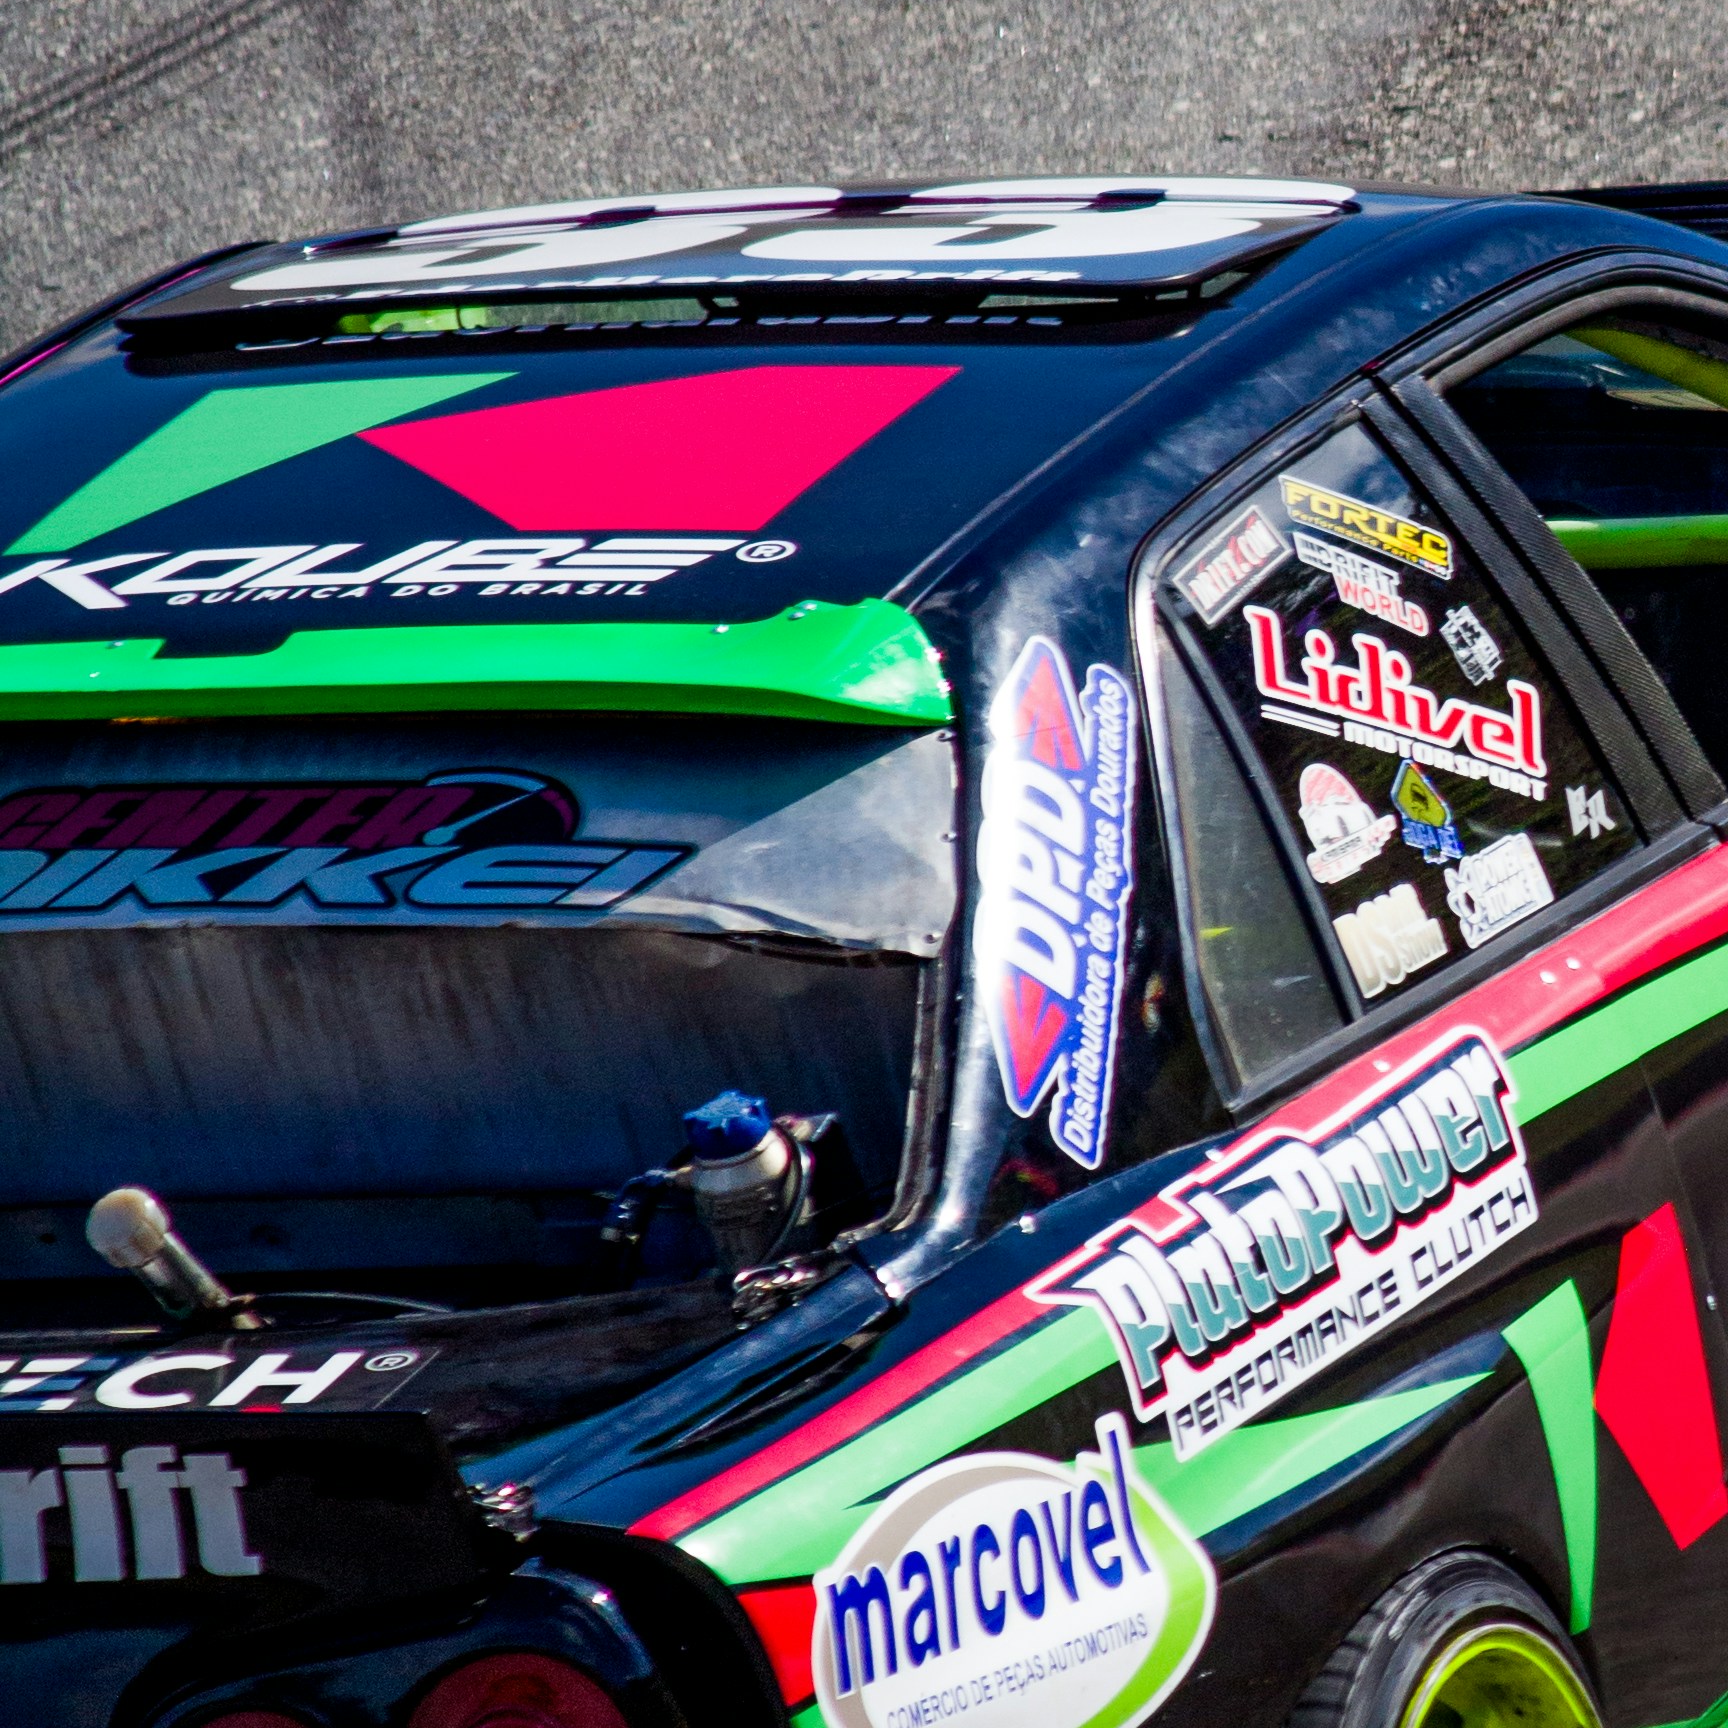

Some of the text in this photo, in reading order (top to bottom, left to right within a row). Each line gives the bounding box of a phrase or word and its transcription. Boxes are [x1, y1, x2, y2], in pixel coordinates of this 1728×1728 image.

[1285, 482, 1449, 566] FORTEC
[1292, 509, 1385, 551] Performance
[390, 583, 462, 598] DO
[477, 582, 650, 597] BRASIL
[1337, 576, 1428, 634] WORLD
[1246, 608, 1545, 776] Lidivel
[1344, 722, 1548, 801] MOTORSPORT
[0, 846, 692, 906] IKKEI
[1000, 759, 1088, 999] DPD
[1063, 678, 1128, 1154] Distribuidora de Peças Dourados
[1077, 1049, 1508, 1387] PlutoPower
[1175, 1178, 1535, 1450] PERFORMANCE CLUTCH
[0, 1353, 364, 1409] ECH
[824, 1429, 1151, 1700] marcovel
[974, 1674, 994, 1704] DE
[996, 1653, 1045, 1697] PEÇAS
[1048, 1613, 1149, 1681] AUTOMOTIVAS
